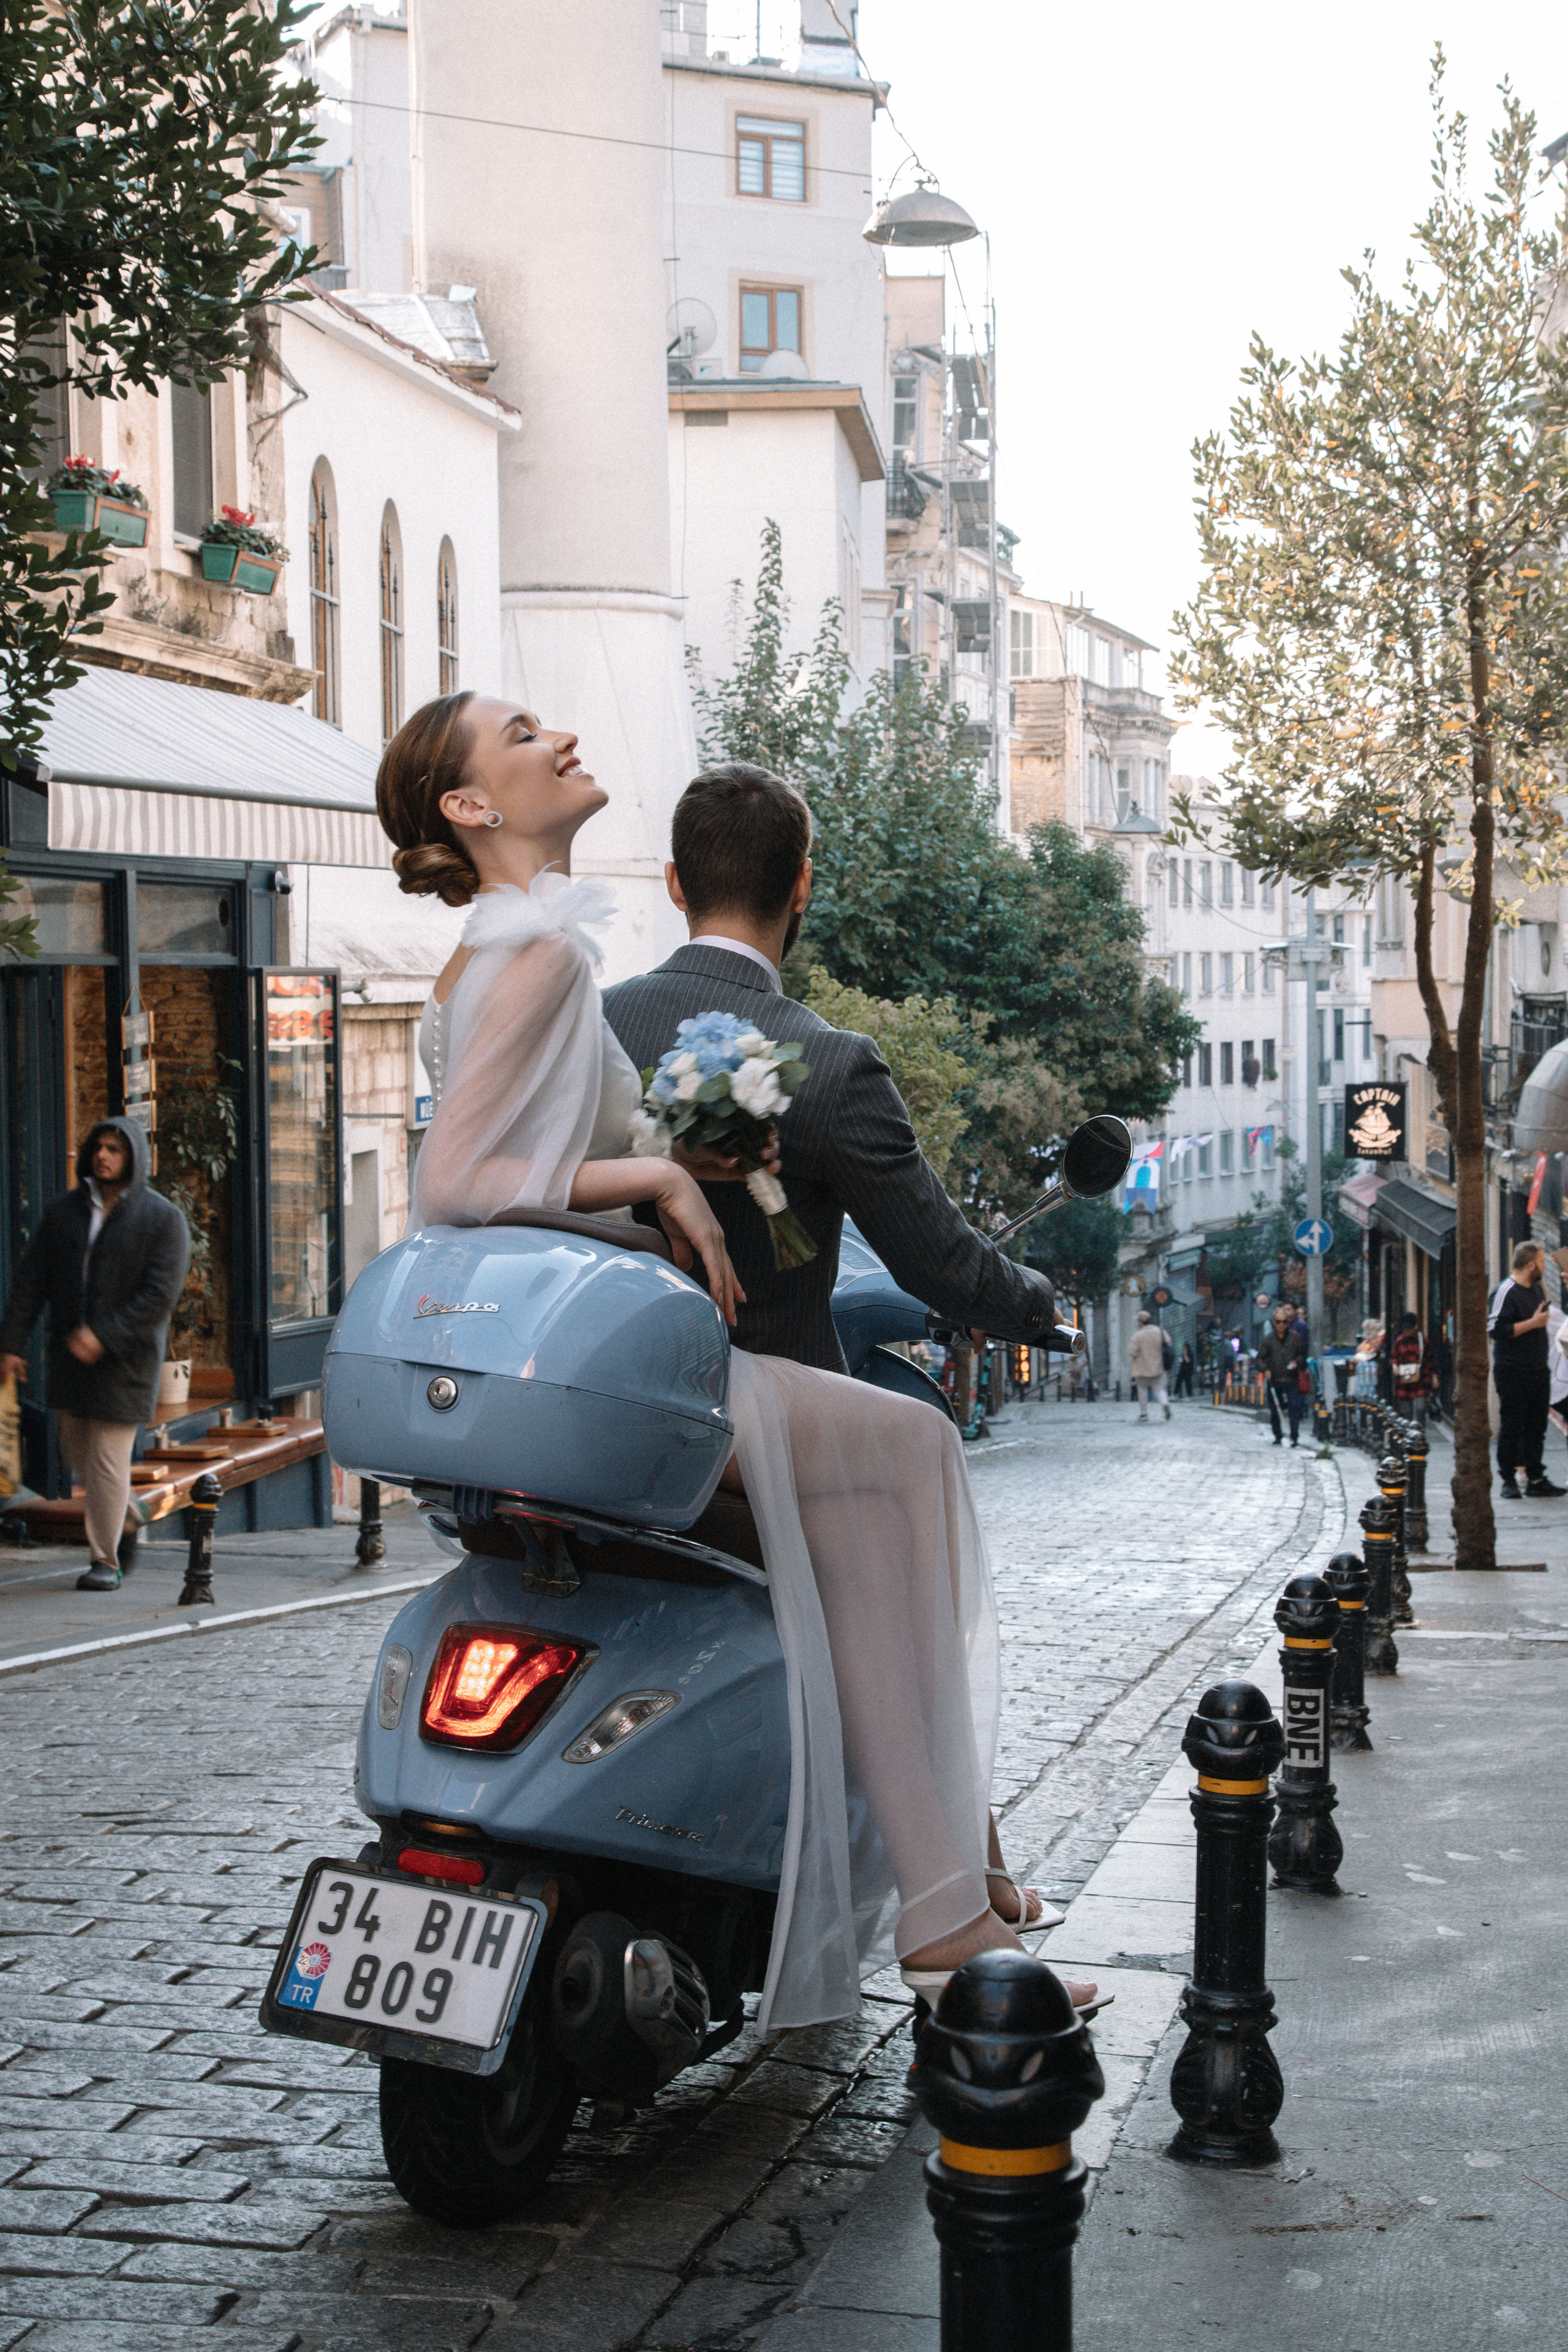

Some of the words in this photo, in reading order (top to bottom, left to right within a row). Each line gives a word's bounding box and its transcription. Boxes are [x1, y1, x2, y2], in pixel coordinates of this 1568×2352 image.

[1353, 1087, 1401, 1106] CAPTAIN
[413, 1293, 501, 1319] Vespa
[1287, 1693, 1321, 1761] BNE
[615, 1805, 704, 1842] Primavera
[317, 1880, 380, 1943] 34
[414, 1899, 514, 1969] BIH
[298, 1954, 309, 1966] 22
[292, 1984, 314, 2004] TR
[344, 1953, 454, 2024] 809
